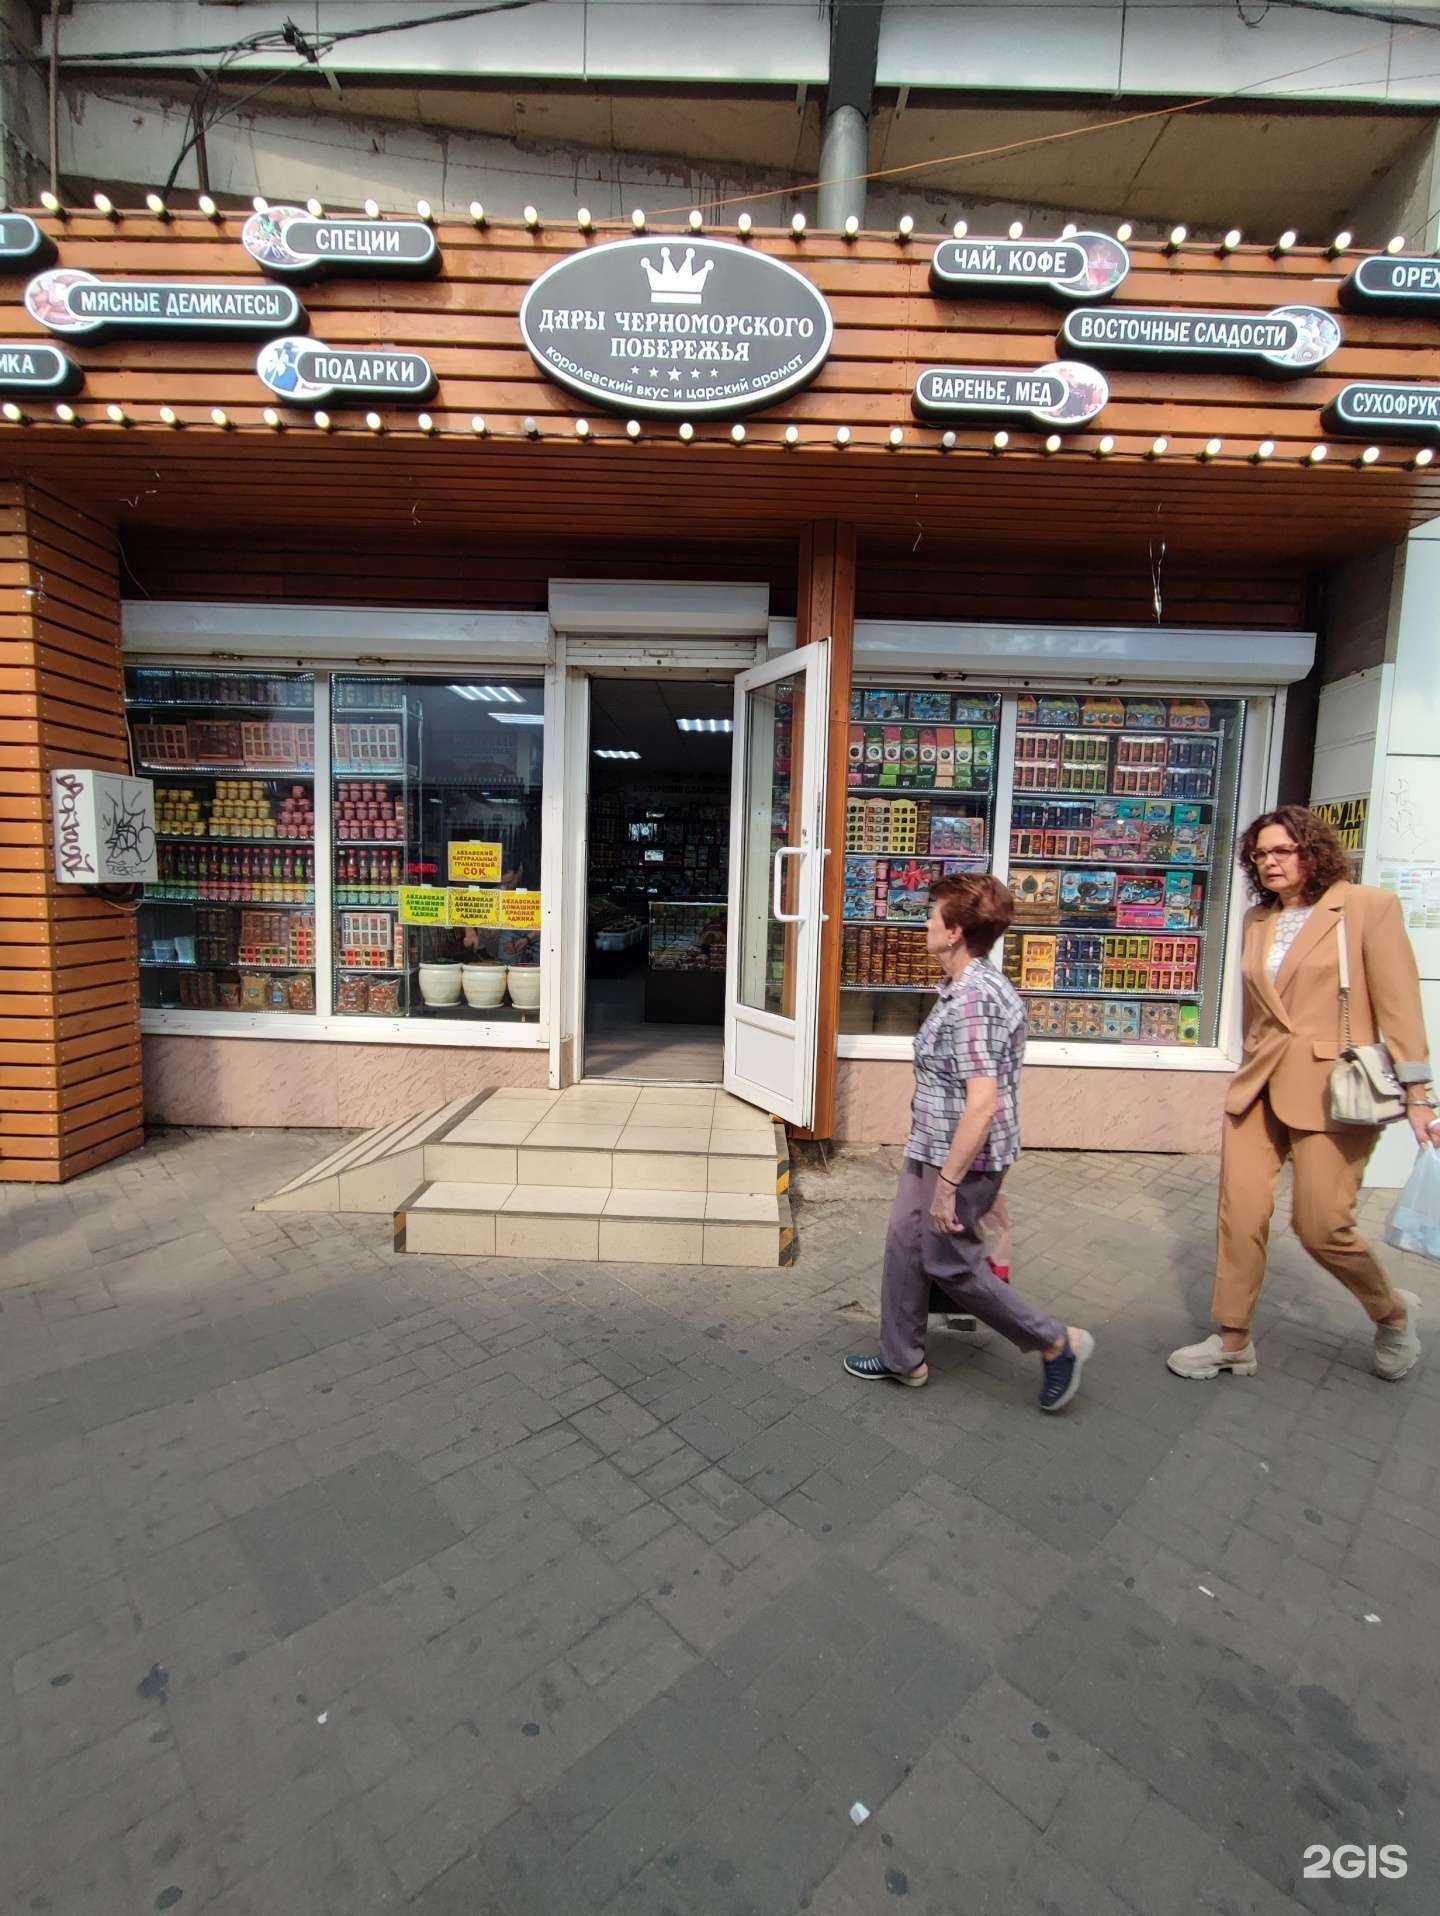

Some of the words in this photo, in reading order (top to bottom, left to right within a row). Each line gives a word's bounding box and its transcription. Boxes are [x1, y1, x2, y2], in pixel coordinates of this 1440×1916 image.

[316, 228, 400, 253] СПЕЦИИ
[954, 246, 1001, 273] ЧАЙ,
[1009, 250, 1067, 273] КОФЕ
[81, 291, 160, 314] МЯСНЫЕ
[166, 293, 280, 317] ДЕЛИКАТЕСЫ
[539, 309, 605, 333] ДАРЫ
[615, 311, 814, 338] ЧЕРНОМОРСКОГО
[1080, 317, 1190, 343] ВОСТОЧНЫЕ
[1194, 323, 1287, 347] СЛАДОСТИ
[610, 337, 750, 362] ПОБЕРЕЖЬЯ
[314, 357, 415, 383] ПОДАРКИ
[546, 345, 633, 394] королевский
[636, 385, 669, 400] вкус
[673, 387, 683, 399] и
[687, 378, 750, 401] царский
[752, 354, 805, 391] аромат
[931, 377, 1011, 403] ВАРЕНЬЕ,
[1015, 382, 1052, 406] МЕД
[463, 867, 486, 876] СОК
